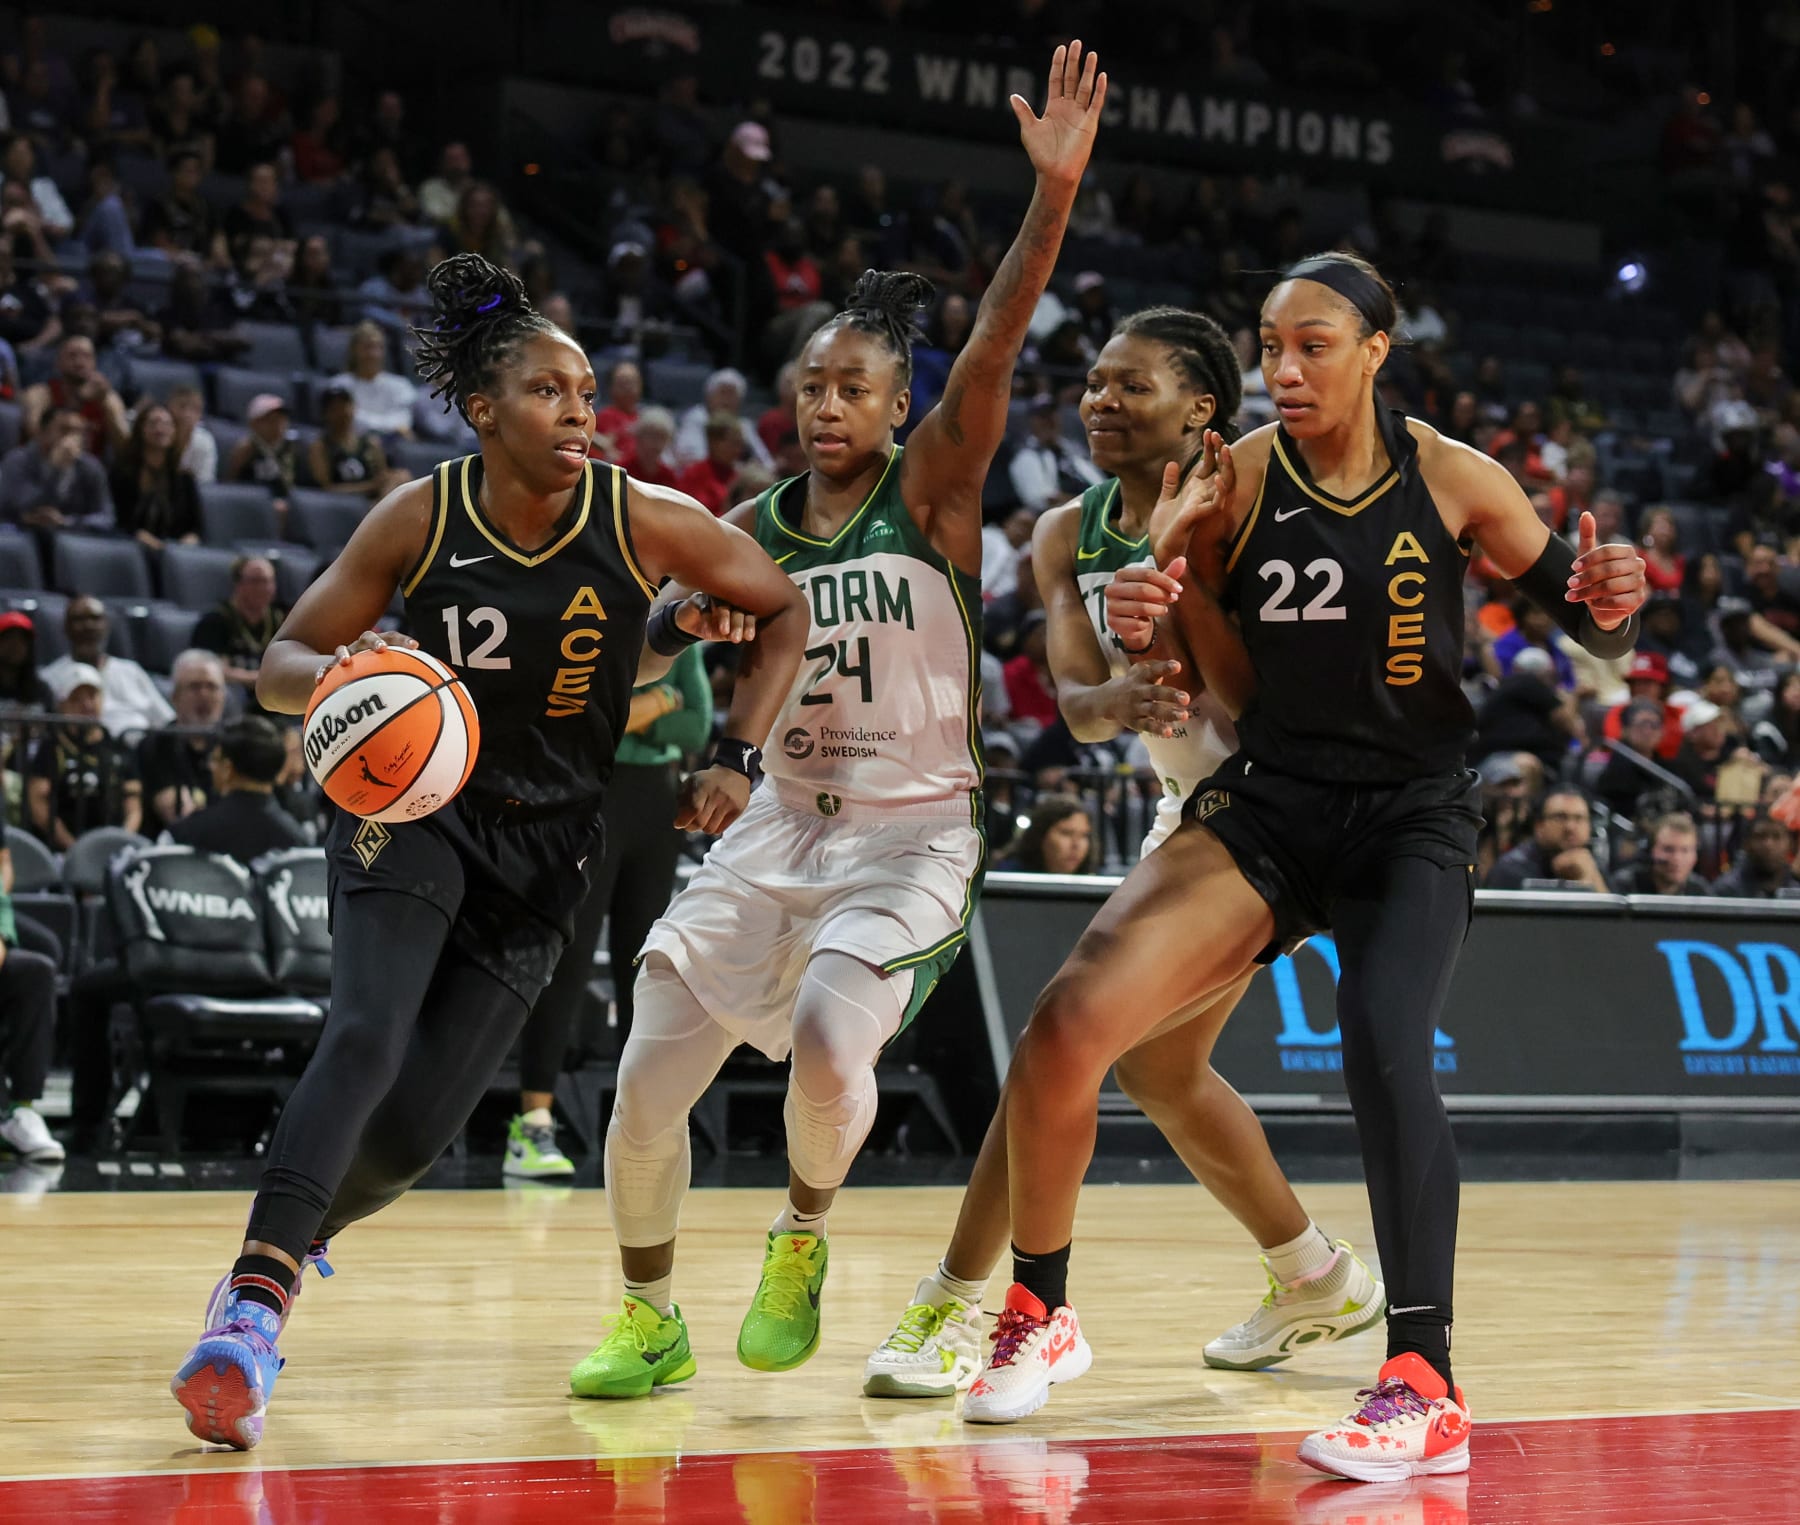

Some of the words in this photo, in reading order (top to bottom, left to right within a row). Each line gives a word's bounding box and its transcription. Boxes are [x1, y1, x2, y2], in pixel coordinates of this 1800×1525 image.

[757, 31, 891, 95] 2022
[914, 53, 1038, 112] WNB
[1102, 83, 1393, 165] CHAMPIONS
[800, 569, 915, 632] ORM
[1257, 557, 1347, 622] 22
[1384, 531, 1431, 687] ACES
[442, 604, 512, 670] 12
[545, 586, 608, 718] ACES
[800, 636, 873, 706] 24
[305, 692, 388, 769] Wilson
[820, 726, 897, 742] Providence
[820, 746, 878, 759] SWEDISH
[147, 887, 256, 921] WNBA
[1656, 940, 1800, 1052] DR
